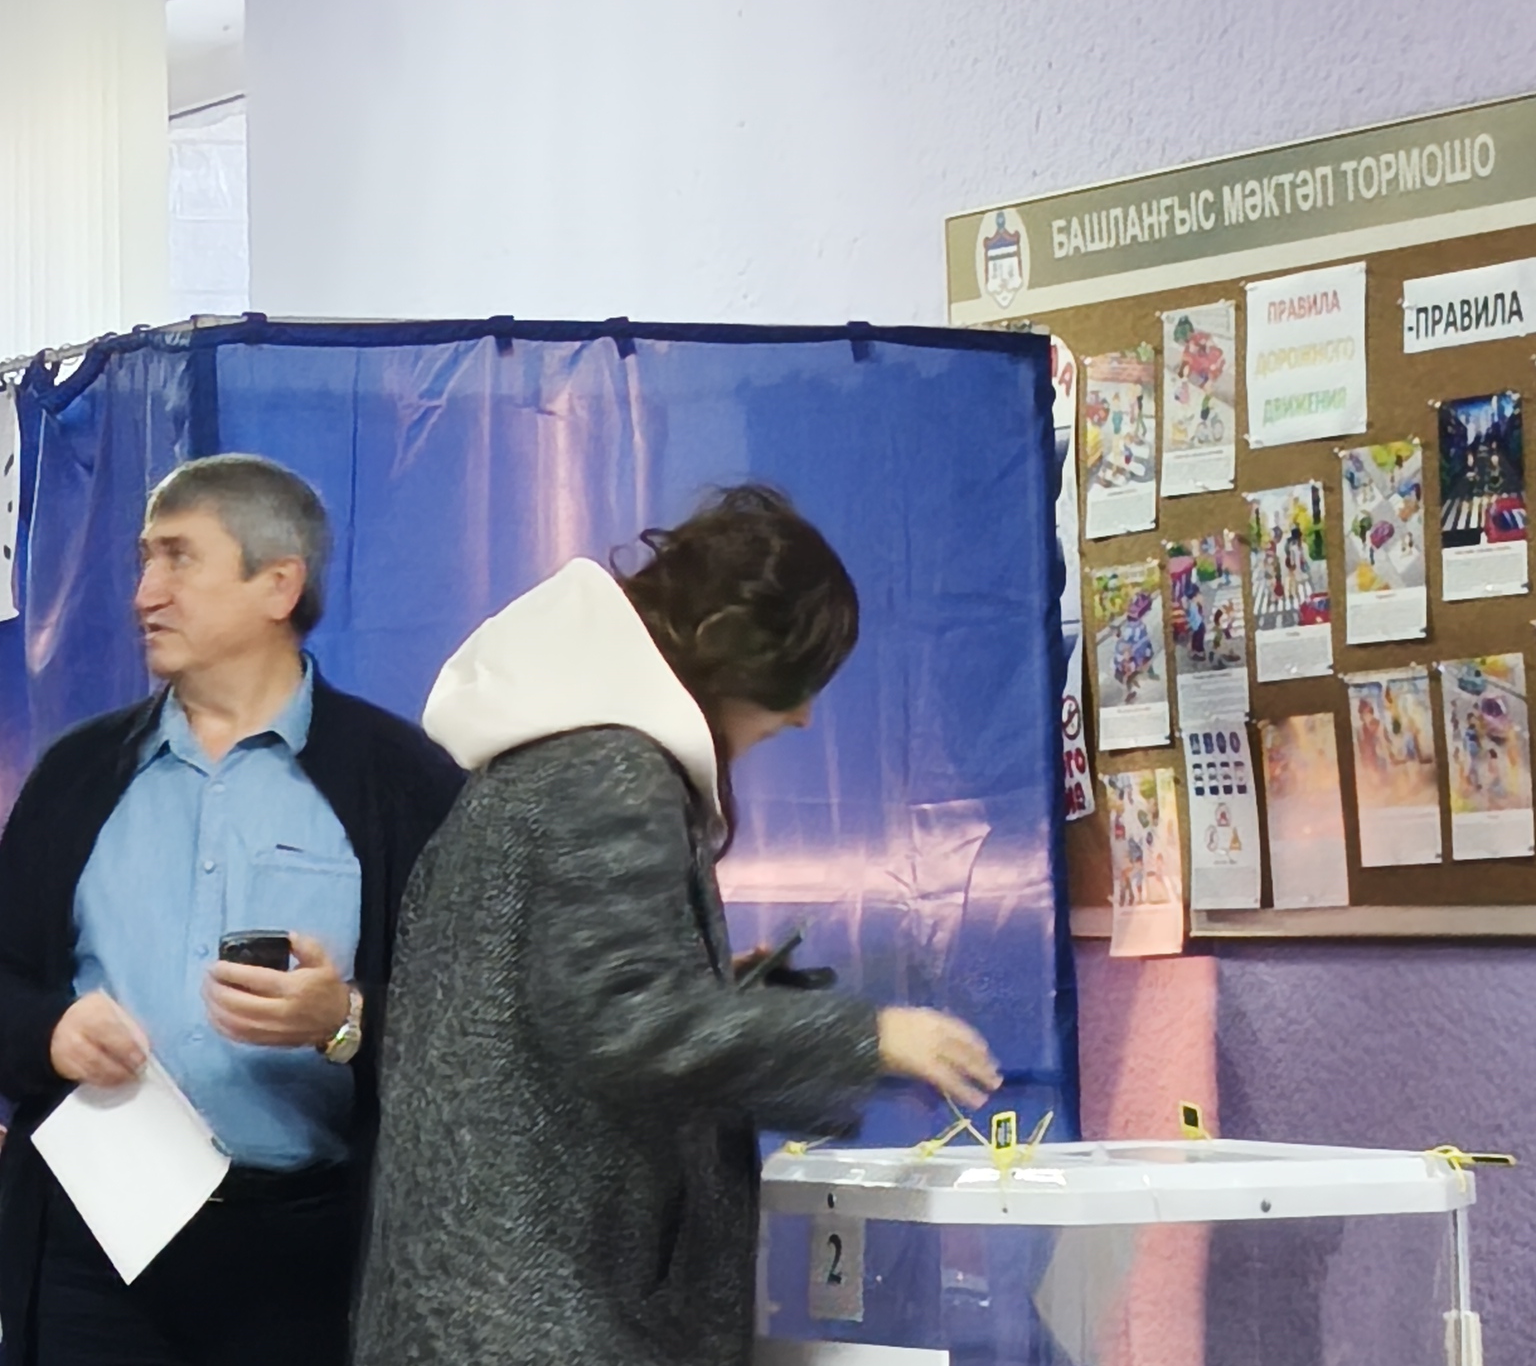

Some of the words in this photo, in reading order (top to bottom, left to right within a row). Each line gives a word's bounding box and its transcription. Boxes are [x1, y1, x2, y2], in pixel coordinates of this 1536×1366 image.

[1051, 189, 1216, 259] БАШЛАНҒЫС
[1222, 165, 1334, 226] МӘКТӘП
[1340, 133, 1496, 202] ТОРМОШО
[1267, 289, 1341, 324] ПРАВИЛА
[827, 1233, 842, 1285] 2
